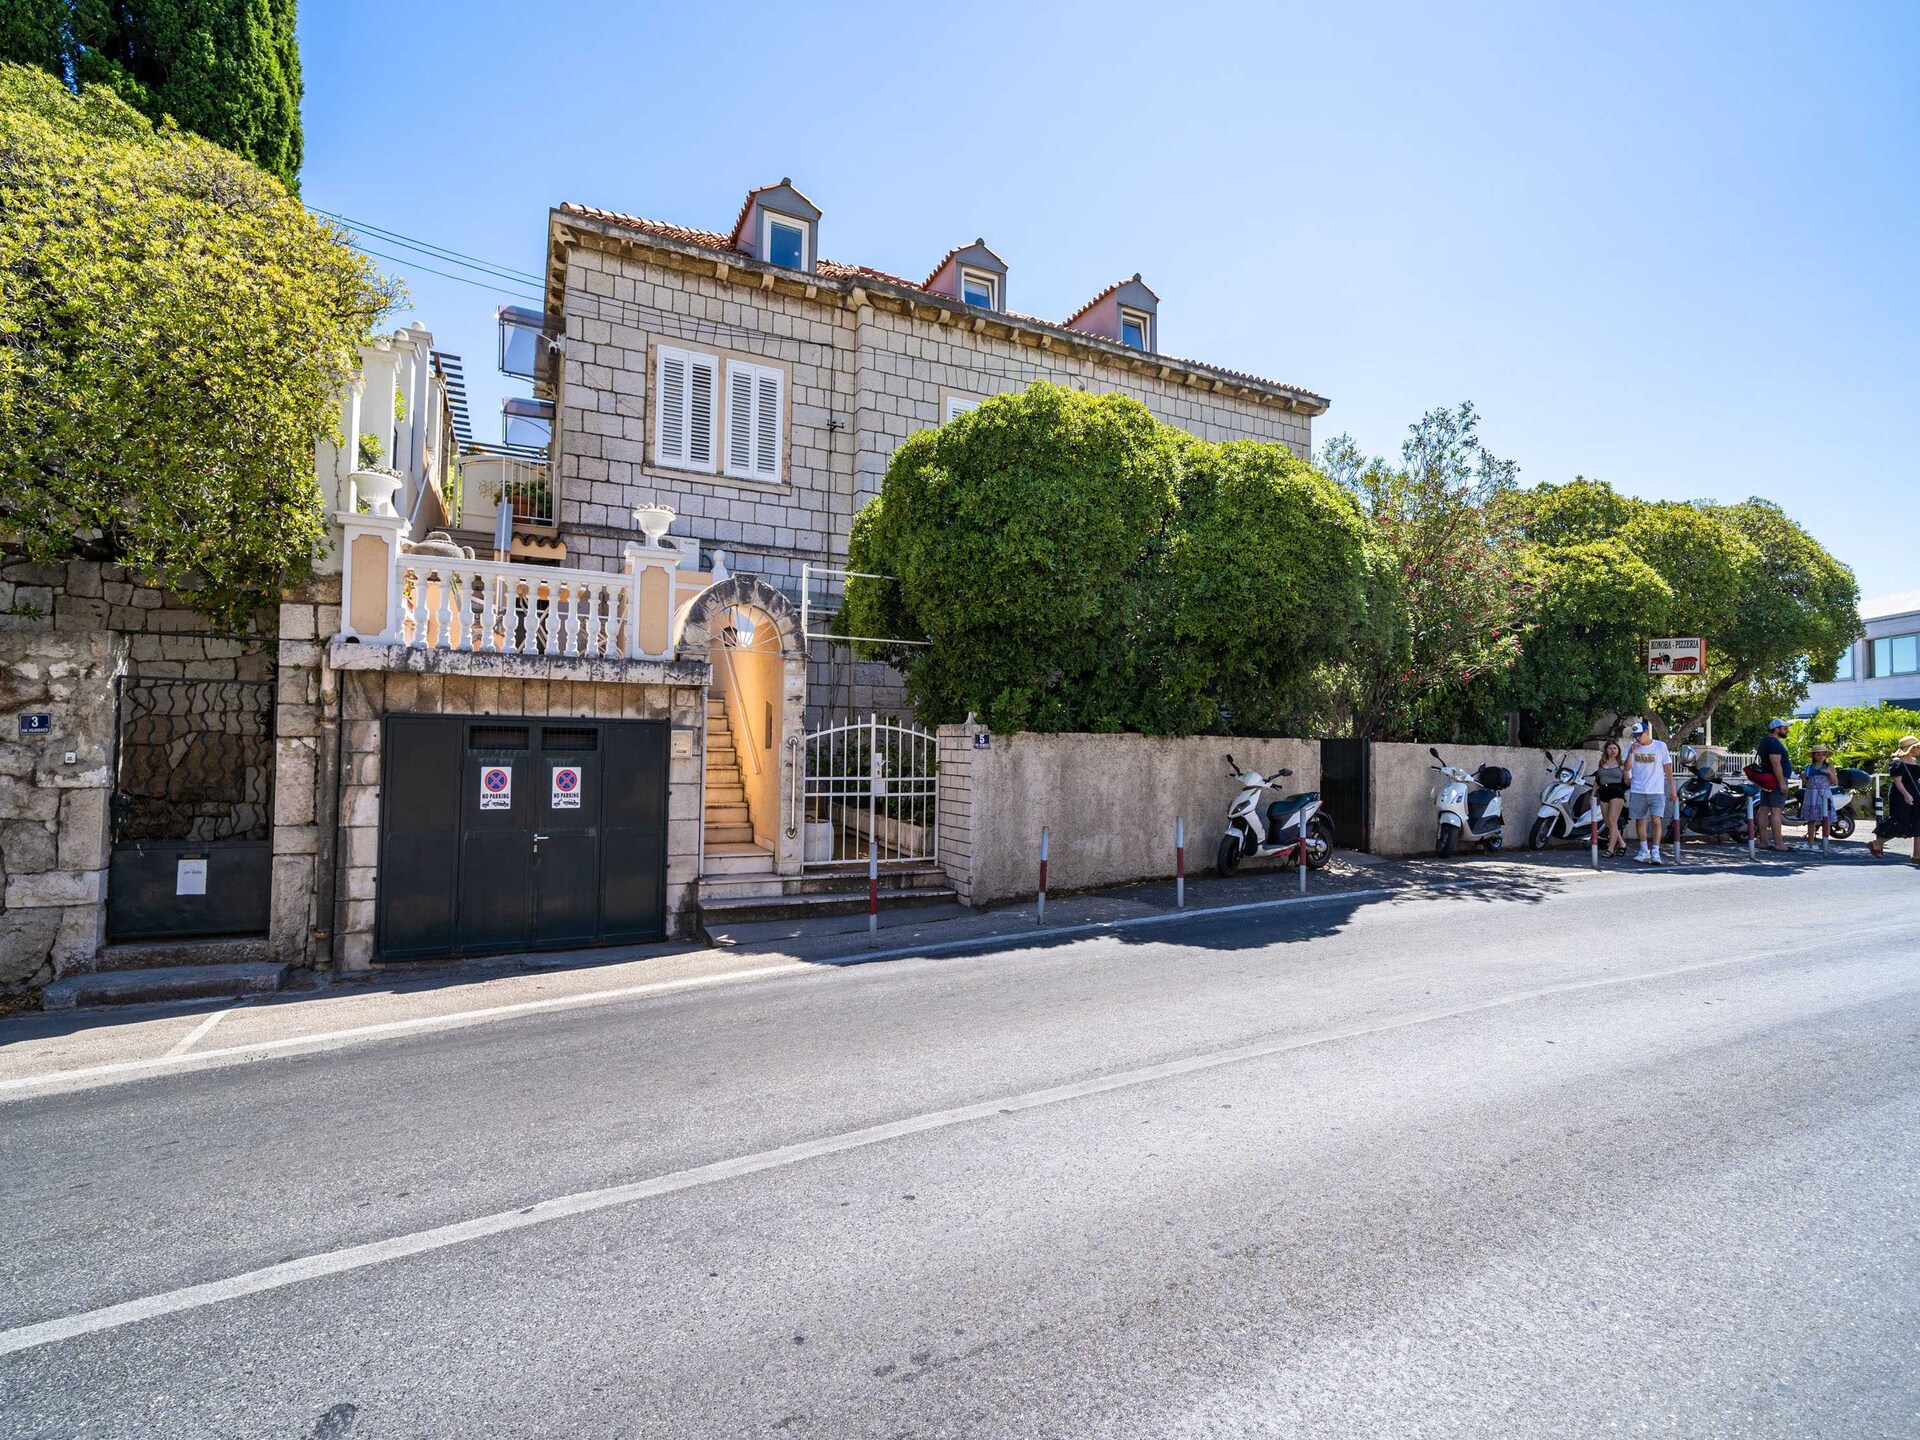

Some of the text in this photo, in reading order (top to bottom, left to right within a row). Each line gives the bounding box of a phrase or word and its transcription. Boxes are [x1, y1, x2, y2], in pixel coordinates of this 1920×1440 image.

[1651, 641, 1671, 650] KONOBA
[1675, 640, 1699, 649] PIZZERIA
[1650, 661, 1696, 671] EL TORO
[31, 716, 39, 727] 3
[979, 734, 985, 744] 5
